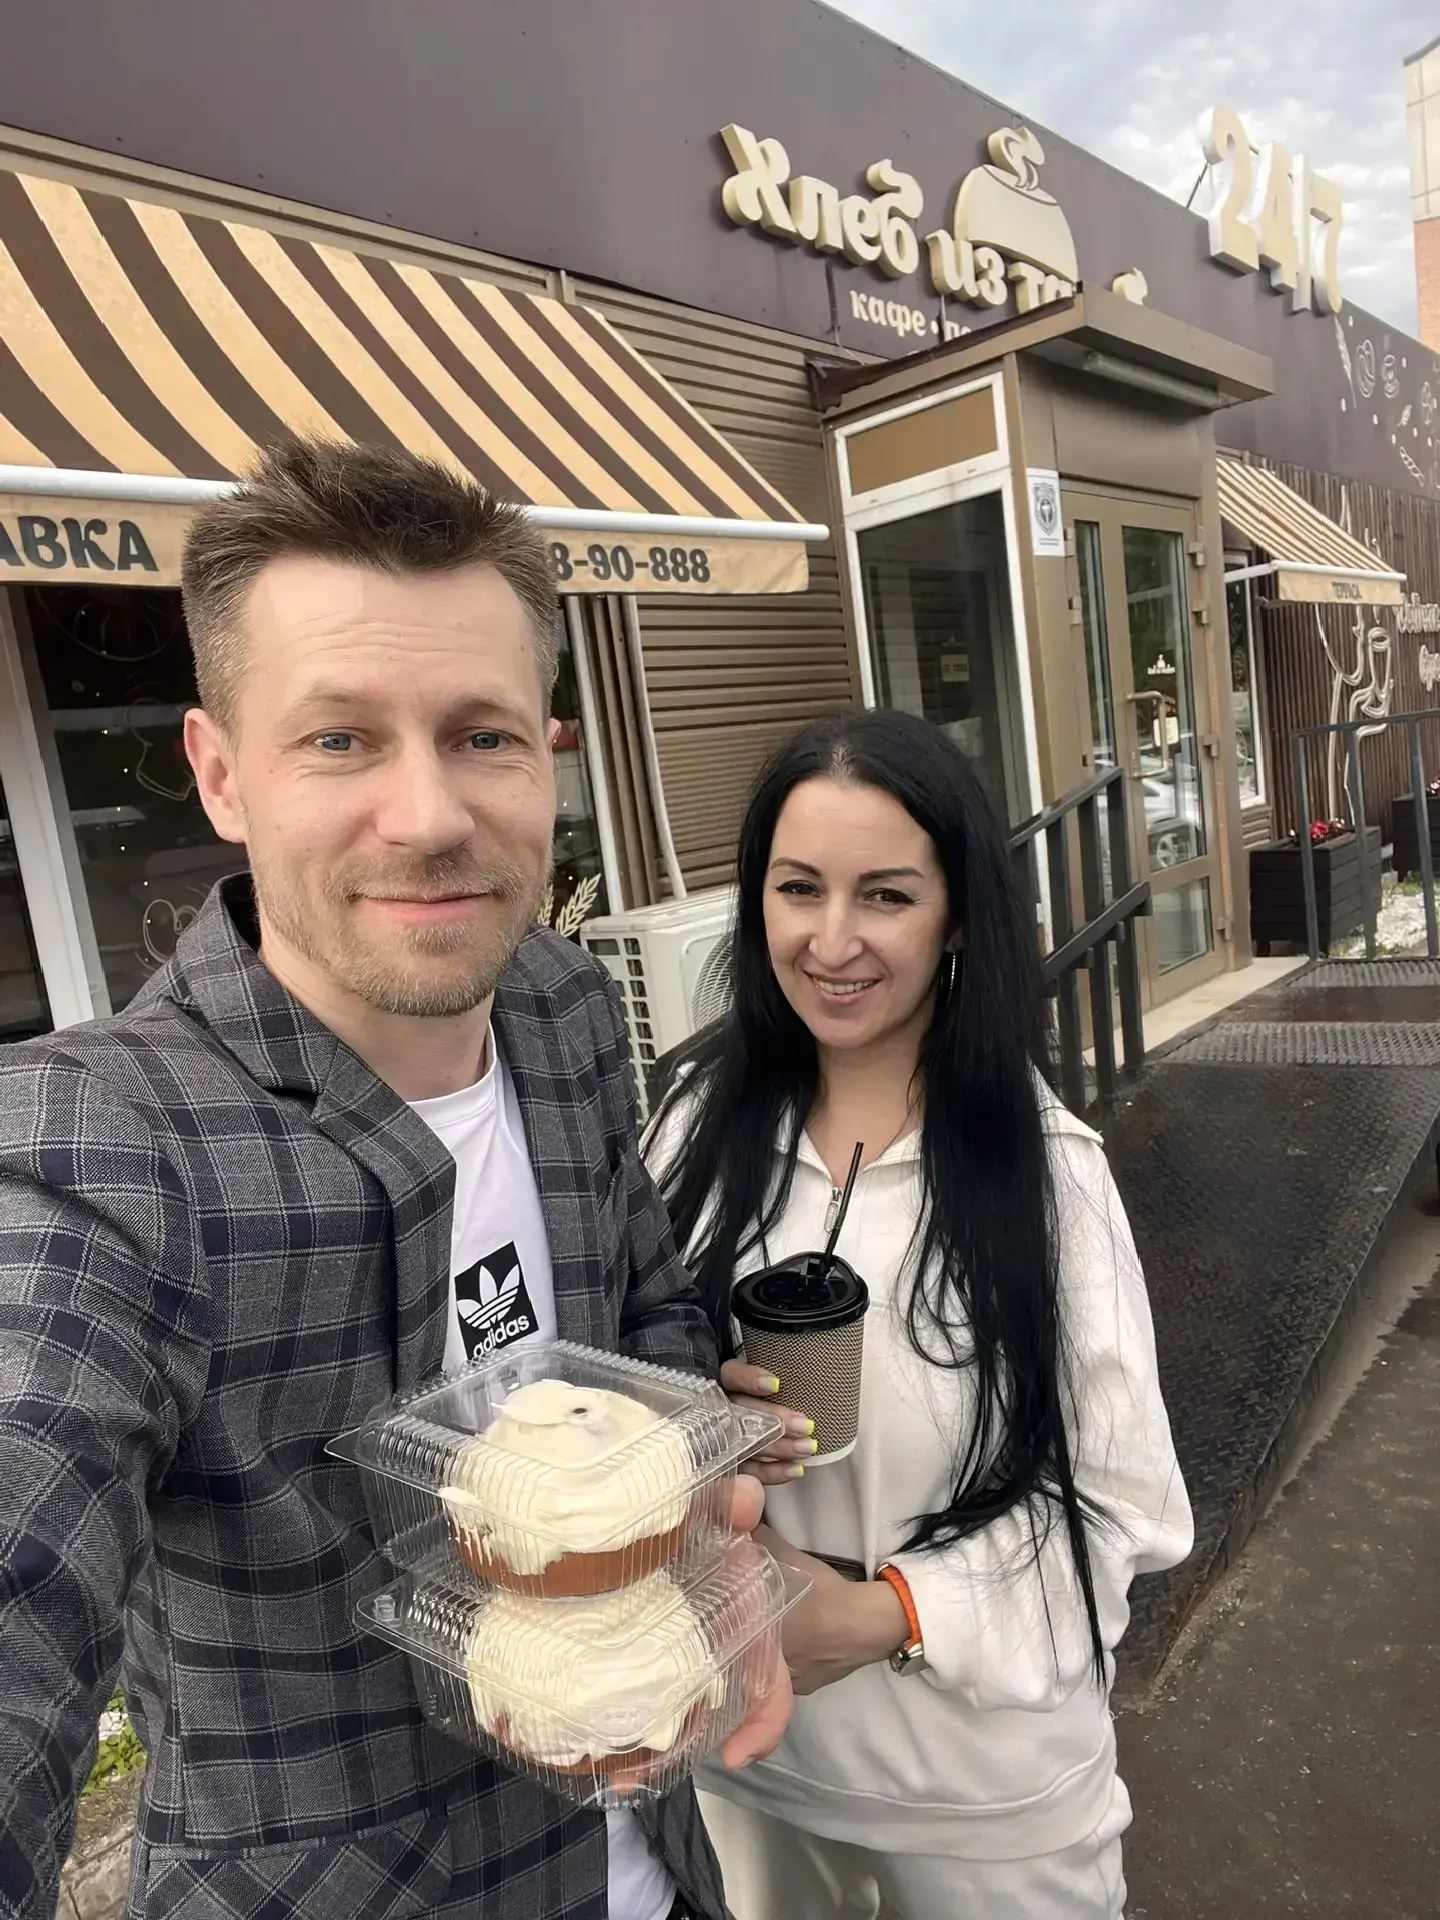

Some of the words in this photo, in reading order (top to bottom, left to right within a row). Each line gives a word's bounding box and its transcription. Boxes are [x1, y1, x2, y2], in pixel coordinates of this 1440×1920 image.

[720, 122, 924, 279] Хлеб
[924, 229, 1008, 309] из
[849, 289, 928, 337] кафе
[473, 1314, 530, 1359] adidas
